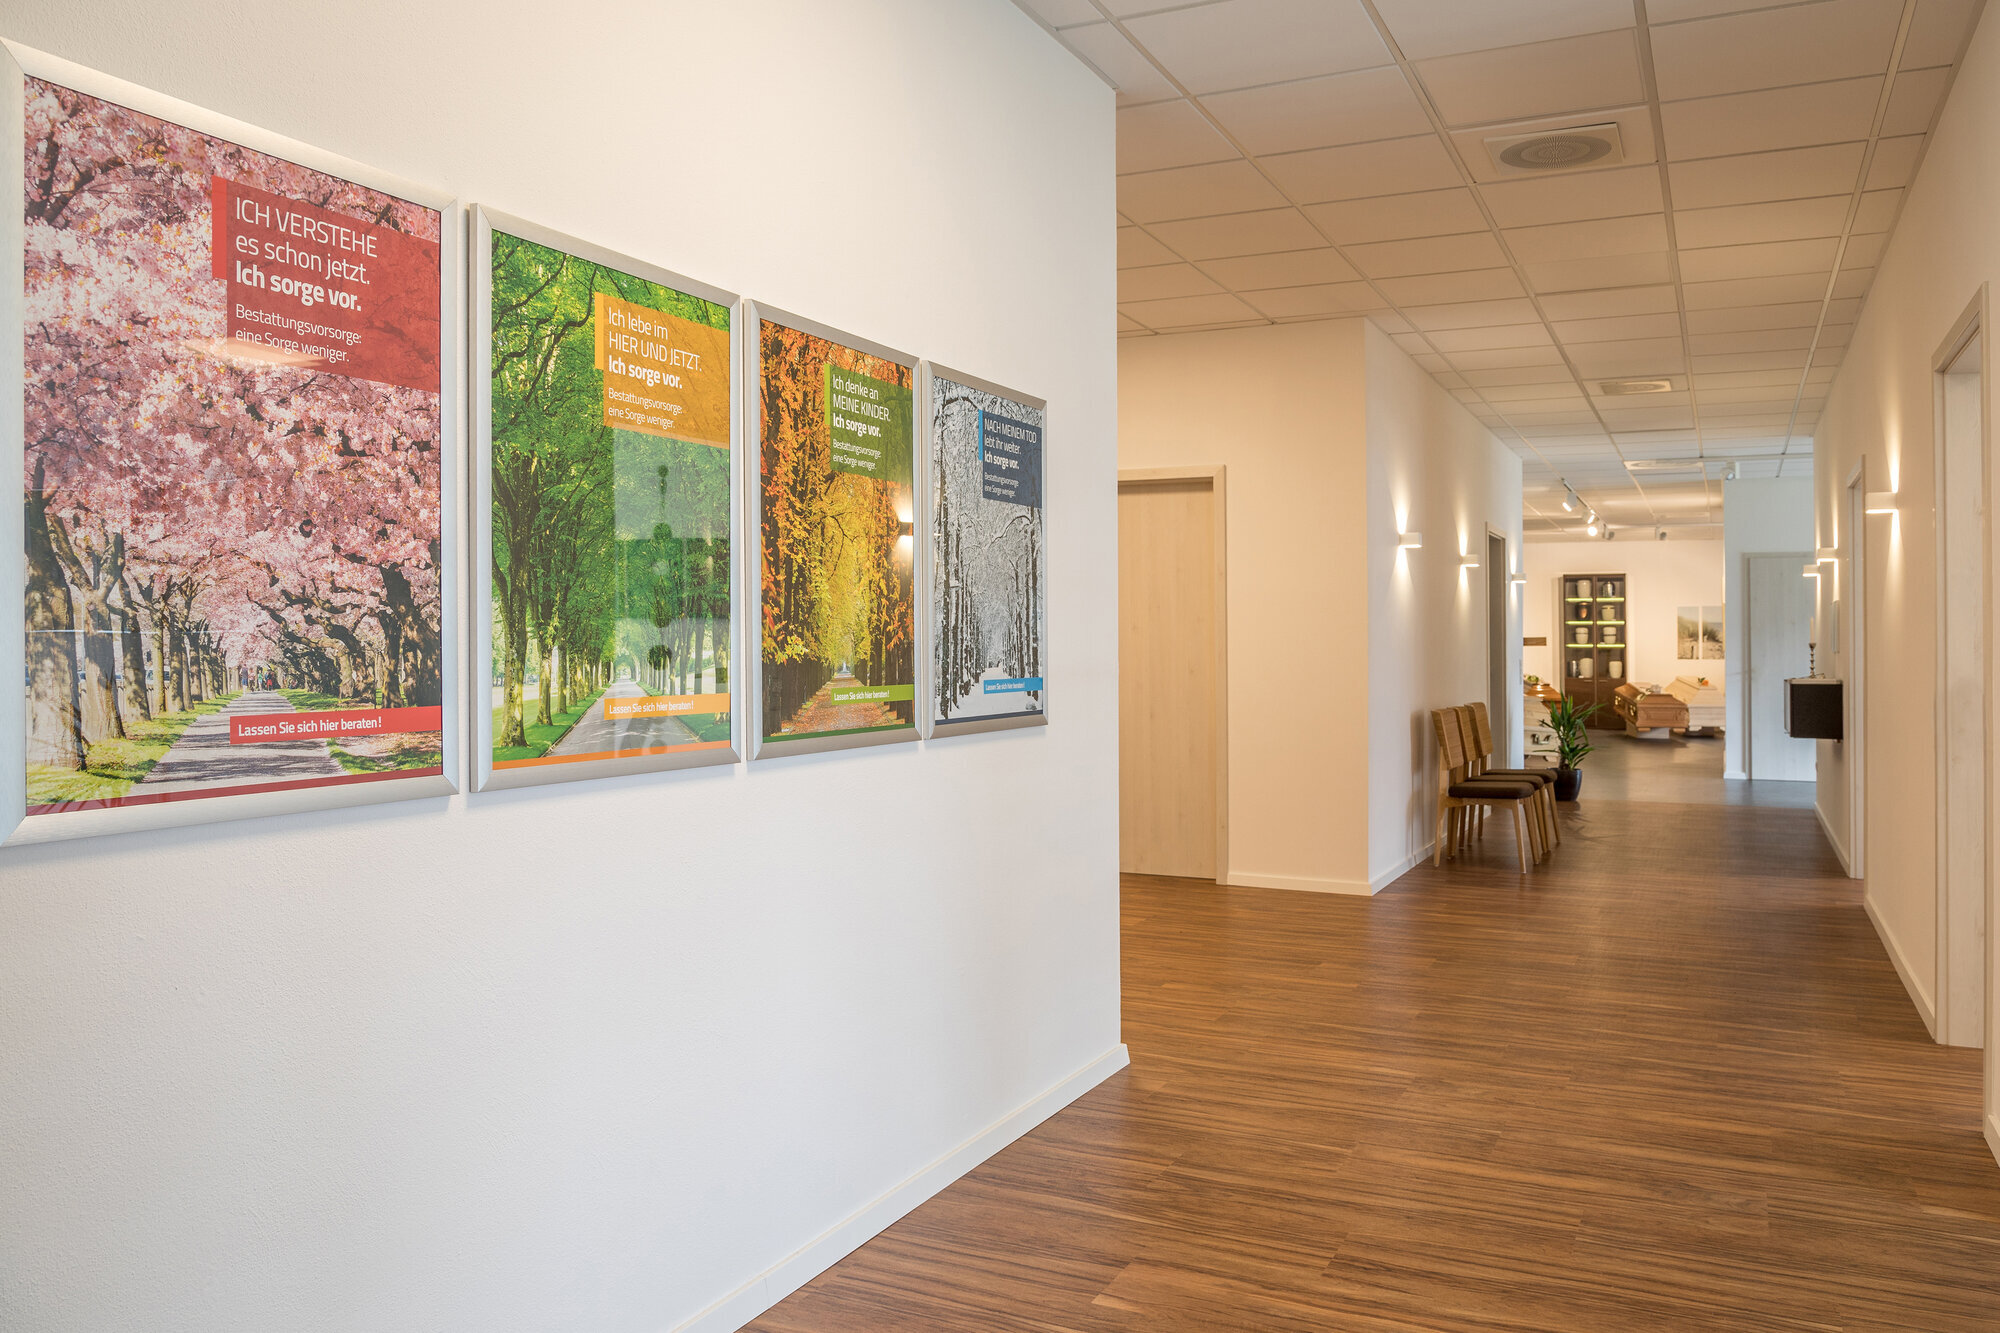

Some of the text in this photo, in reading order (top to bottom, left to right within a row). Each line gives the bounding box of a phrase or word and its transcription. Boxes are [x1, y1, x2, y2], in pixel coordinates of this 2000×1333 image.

[237, 197, 377, 258] ICH VERSTEHE
[236, 235, 370, 284] es schon jetzt.
[236, 260, 361, 311] Ich sorge vor.
[236, 304, 361, 345] Bestattungsvorsorge:
[609, 307, 668, 340] Ich lebe im
[236, 328, 349, 363] eine Sorge weniger.
[610, 331, 702, 371] HIER UND JETZT.
[609, 355, 682, 389] Ich sorge vor.
[833, 374, 878, 400] Ich denke an
[609, 388, 682, 415] Bestattungsvorsorge:
[833, 394, 890, 422] MEINE KINDER.
[609, 406, 675, 430] eine Sorge weniger.
[833, 413, 881, 437] Ich sorge vor.
[985, 418, 1036, 443] NACH MEINEM TOD
[833, 453, 843, 462] eine
[844, 455, 857, 467] Sorge
[994, 455, 1008, 469] sorge
[609, 705, 631, 714] Lassen
[632, 704, 641, 712] Sie
[643, 702, 655, 712] sich
[656, 702, 667, 711] hier
[238, 724, 277, 736] Lassen
[279, 722, 295, 734] Sie
[297, 720, 318, 733] sich
[320, 719, 338, 731] hier
